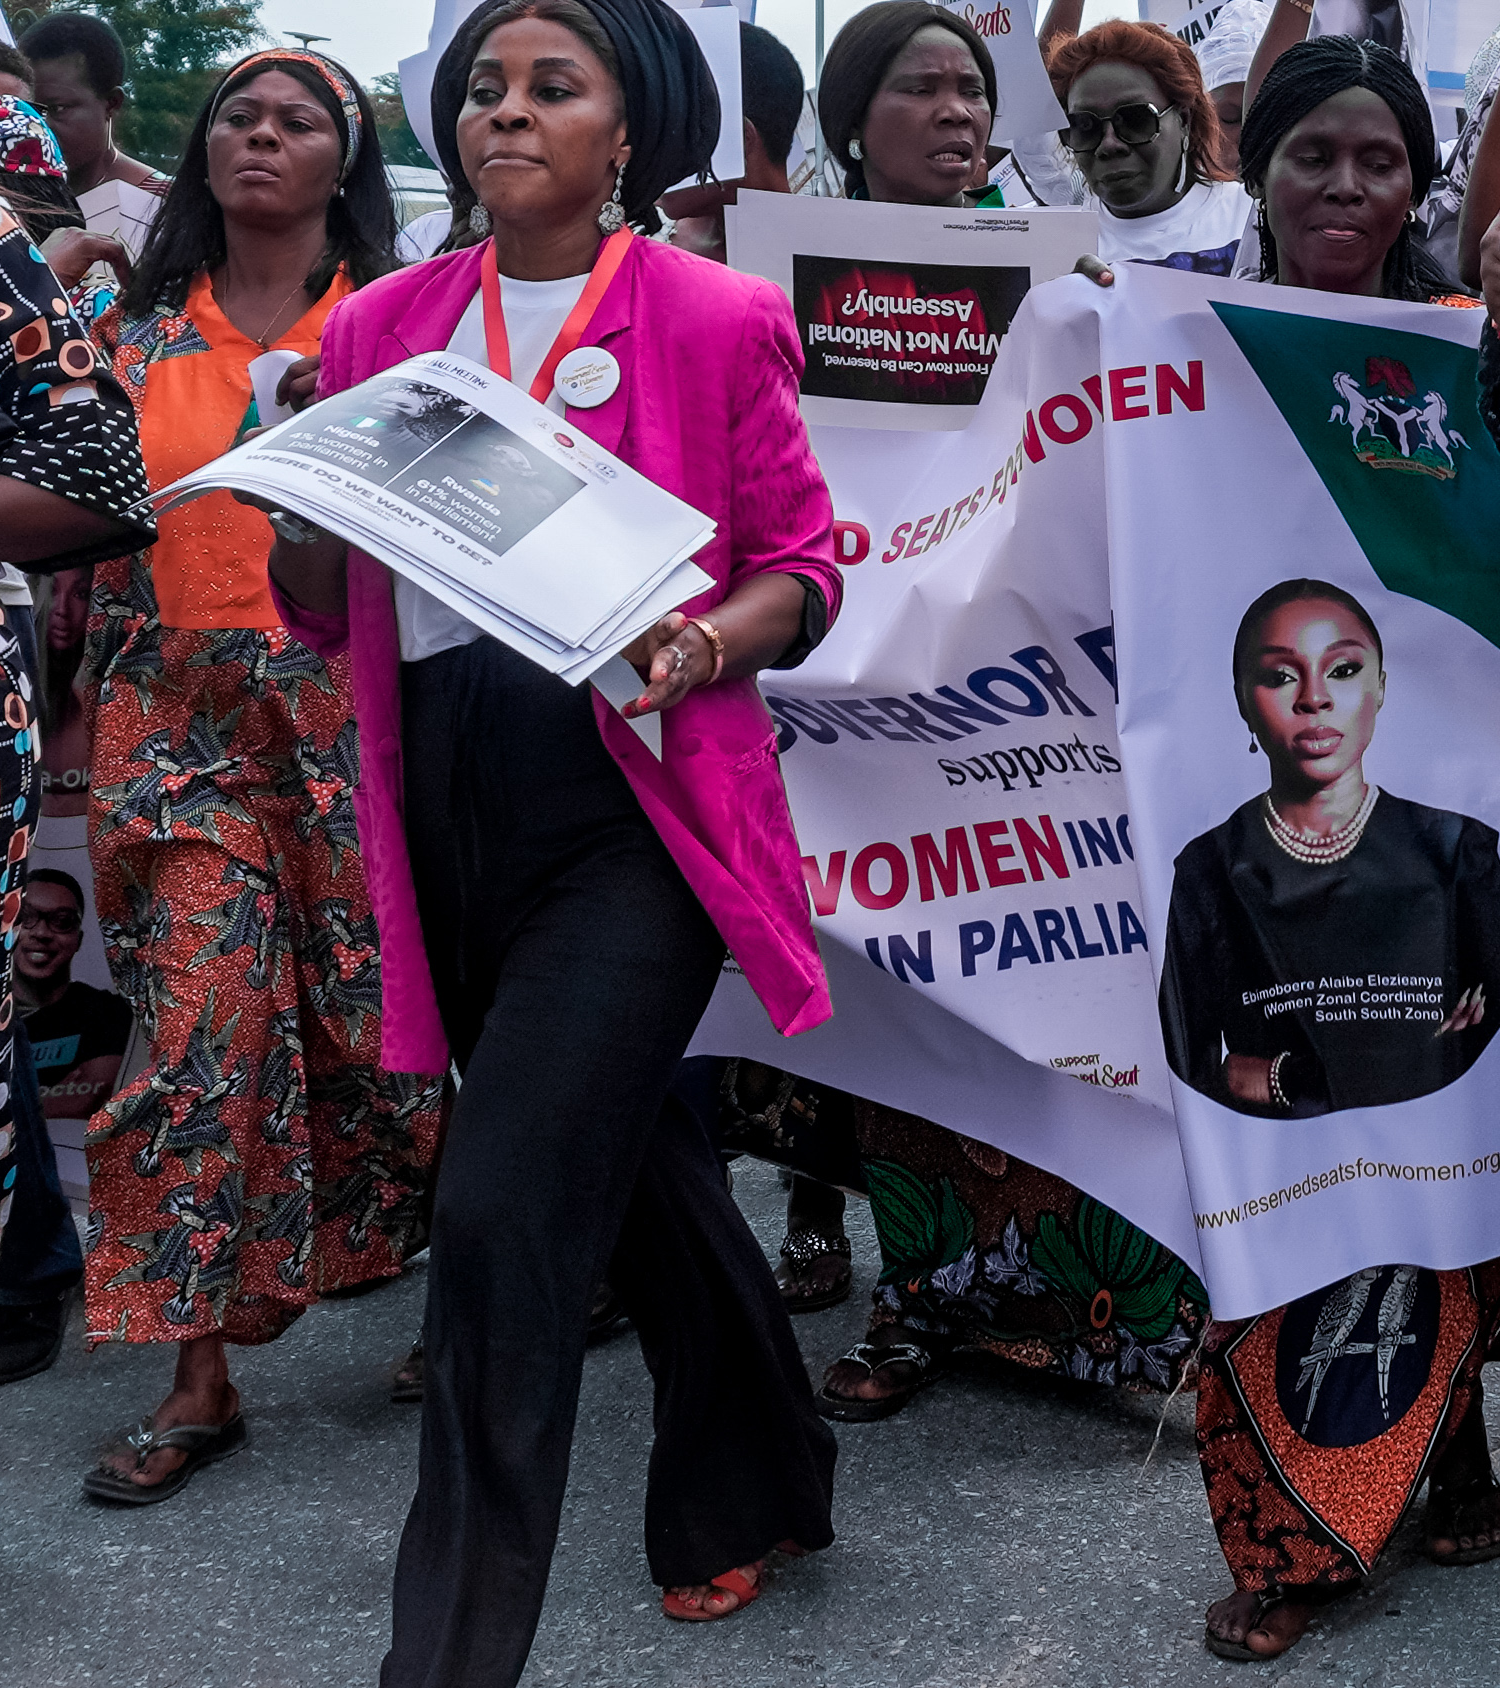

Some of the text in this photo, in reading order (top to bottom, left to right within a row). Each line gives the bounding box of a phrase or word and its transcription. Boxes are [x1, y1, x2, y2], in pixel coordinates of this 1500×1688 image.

[965, 1, 1011, 37] Seats
[841, 289, 974, 322] Assembly?
[808, 323, 901, 352] National
[906, 331, 949, 354] Not
[450, 363, 489, 390] MEETING
[822, 352, 989, 375] Front Row Can Be Reserved,
[289, 431, 389, 468] 4% women in
[324, 423, 380, 447] Nigeria
[287, 439, 369, 471] parliament
[246, 453, 310, 476] WHERE
[313, 466, 342, 483] DO
[344, 479, 374, 498] WE
[376, 496, 430, 529] WANT
[431, 526, 457, 545] TO
[457, 543, 493, 569] BE?
[416, 478, 449, 503] 61%
[450, 495, 503, 535] women
[441, 475, 502, 517] Rwanda
[404, 485, 421, 502] in
[418, 492, 497, 544] parliament
[937, 733, 1122, 791] supports
[959, 900, 1149, 978] PARLIA
[1319, 977, 1364, 989] Alaibe
[1264, 990, 1444, 1020] (Women Zonal Coordinator
[1315, 1006, 1444, 1023] South South Zone)
[1054, 1054, 1100, 1068] SUPPORT
[1102, 1064, 1140, 1088] Seat
[1194, 1151, 1500, 1230] www.reservedseatsforwomen.org
